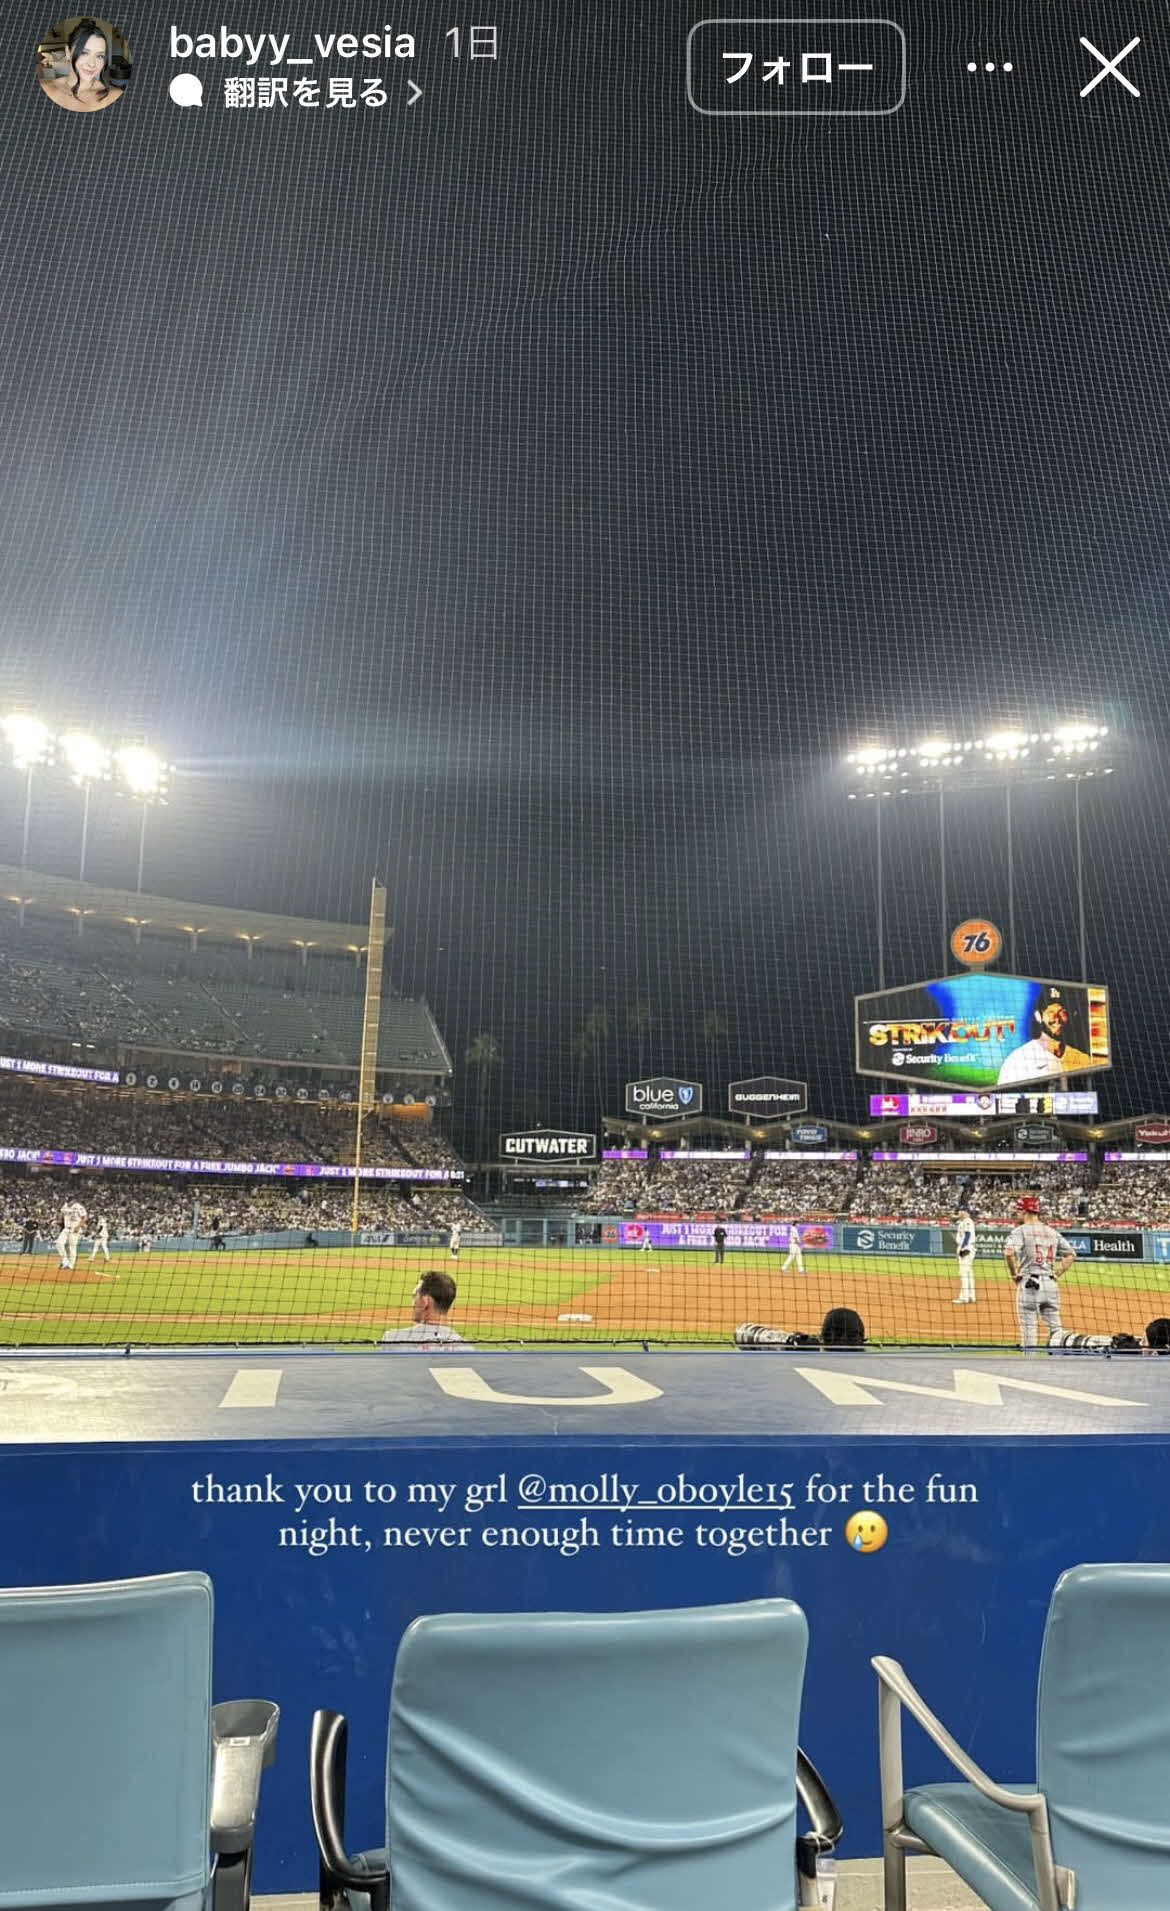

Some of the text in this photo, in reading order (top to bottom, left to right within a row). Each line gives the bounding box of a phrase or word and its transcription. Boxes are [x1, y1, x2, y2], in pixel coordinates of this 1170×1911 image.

[963, 931, 991, 953] 76
[905, 1053, 942, 1065] Security
[23, 1060, 47, 1074] MORE
[48, 1063, 95, 1080] STRIKEOUT
[94, 1069, 111, 1081] FOR
[112, 1071, 119, 1083] A
[633, 1085, 675, 1102] blue
[735, 1093, 800, 1101] GUGGENHEIM
[639, 1103, 679, 1111] california
[505, 1137, 588, 1153] CUTWATER
[77, 1153, 97, 1166] JUST
[103, 1155, 126, 1168] MORE
[127, 1157, 173, 1171] STRIKEOUT
[174, 1159, 191, 1171] FOR
[222, 1162, 253, 1174] JUMBO
[319, 1165, 340, 1177] JUST
[375, 1167, 423, 1179] STRIKEOUT
[424, 1169, 442, 1180] FOR
[661, 1223, 682, 1235] JUST
[769, 1225, 788, 1237] FOR
[877, 1229, 916, 1241] Security
[878, 1239, 911, 1250] Benefit
[1093, 1239, 1135, 1252] Health
[1034, 1243, 1055, 1265] 54
